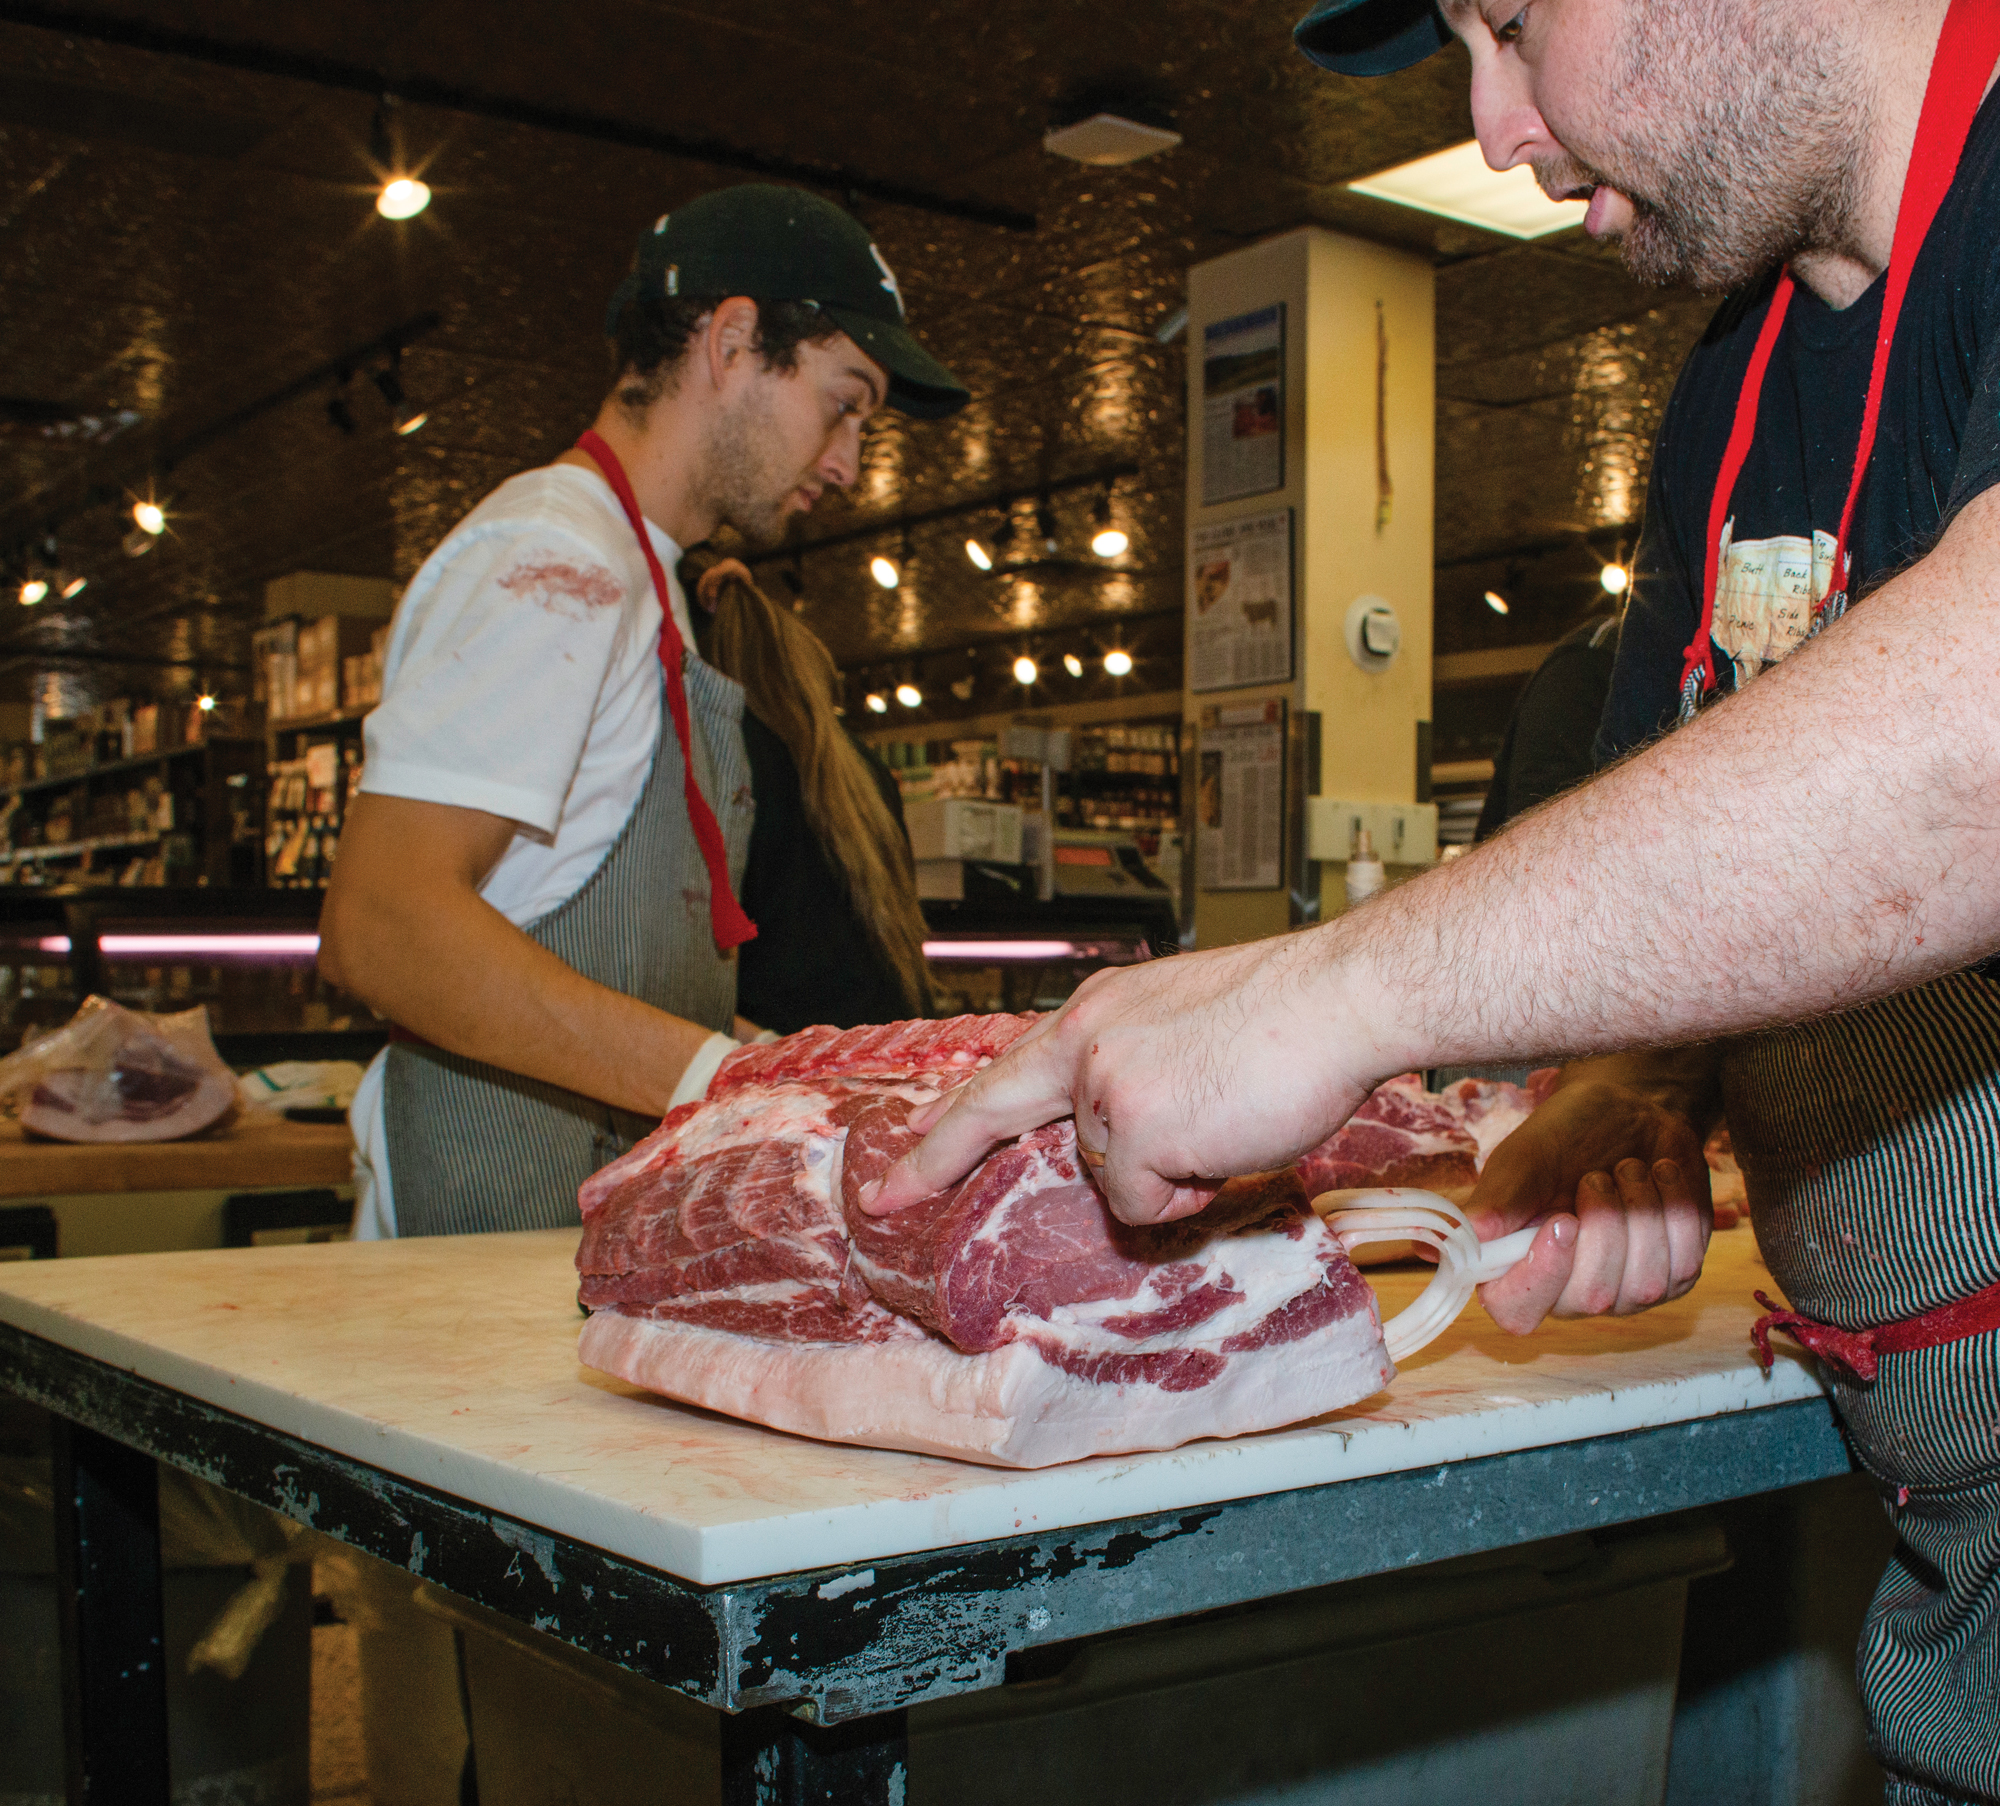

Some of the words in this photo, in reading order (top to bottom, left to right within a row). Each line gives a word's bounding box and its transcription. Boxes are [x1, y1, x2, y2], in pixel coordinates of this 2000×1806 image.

[1741, 562, 1764, 575] Butt
[1783, 568, 1808, 579] Back
[1778, 608, 1800, 619] Side
[1787, 625, 1806, 637] Ribs
